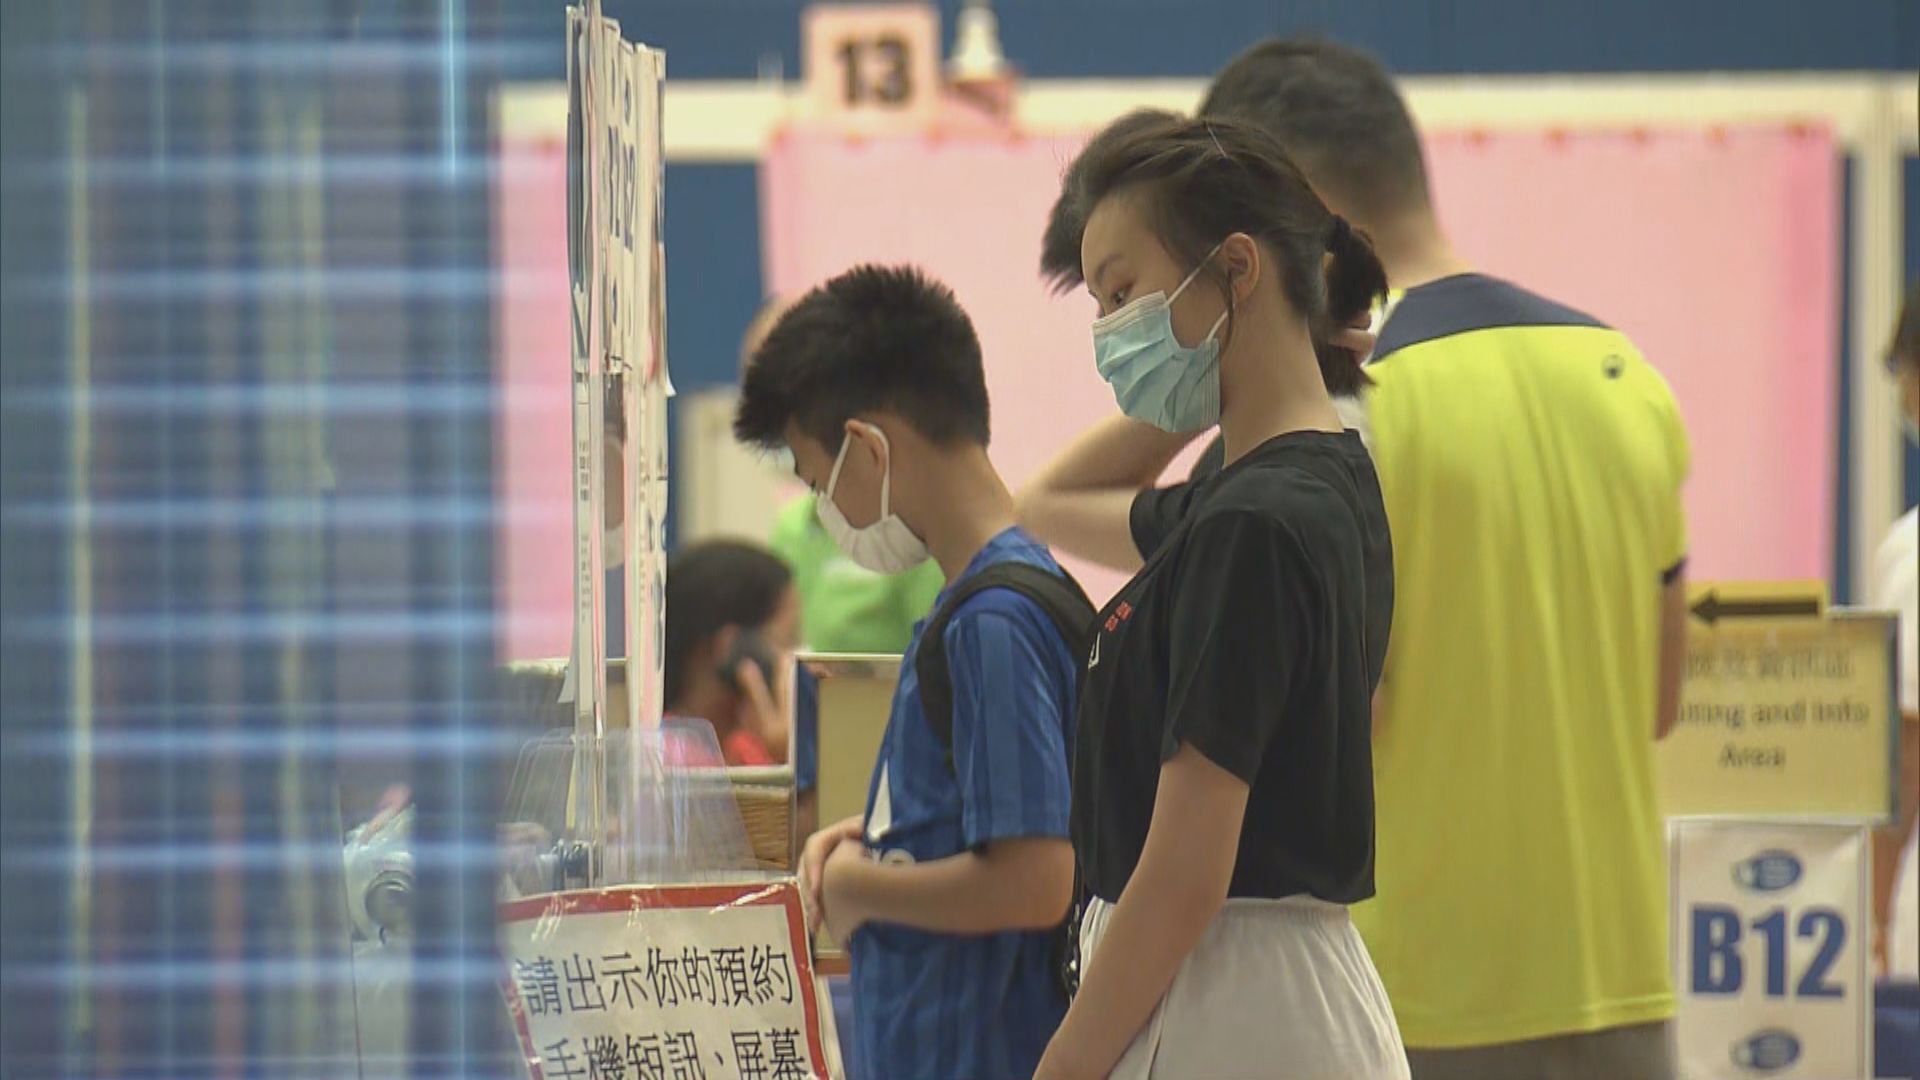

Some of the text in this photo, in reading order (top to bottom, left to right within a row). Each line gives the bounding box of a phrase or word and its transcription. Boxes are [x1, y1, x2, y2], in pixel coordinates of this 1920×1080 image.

[836, 37, 912, 109] 13
[1719, 742, 1786, 769] Area
[515, 944, 794, 1016] 請出示你的預約
[1688, 903, 1846, 998] B12
